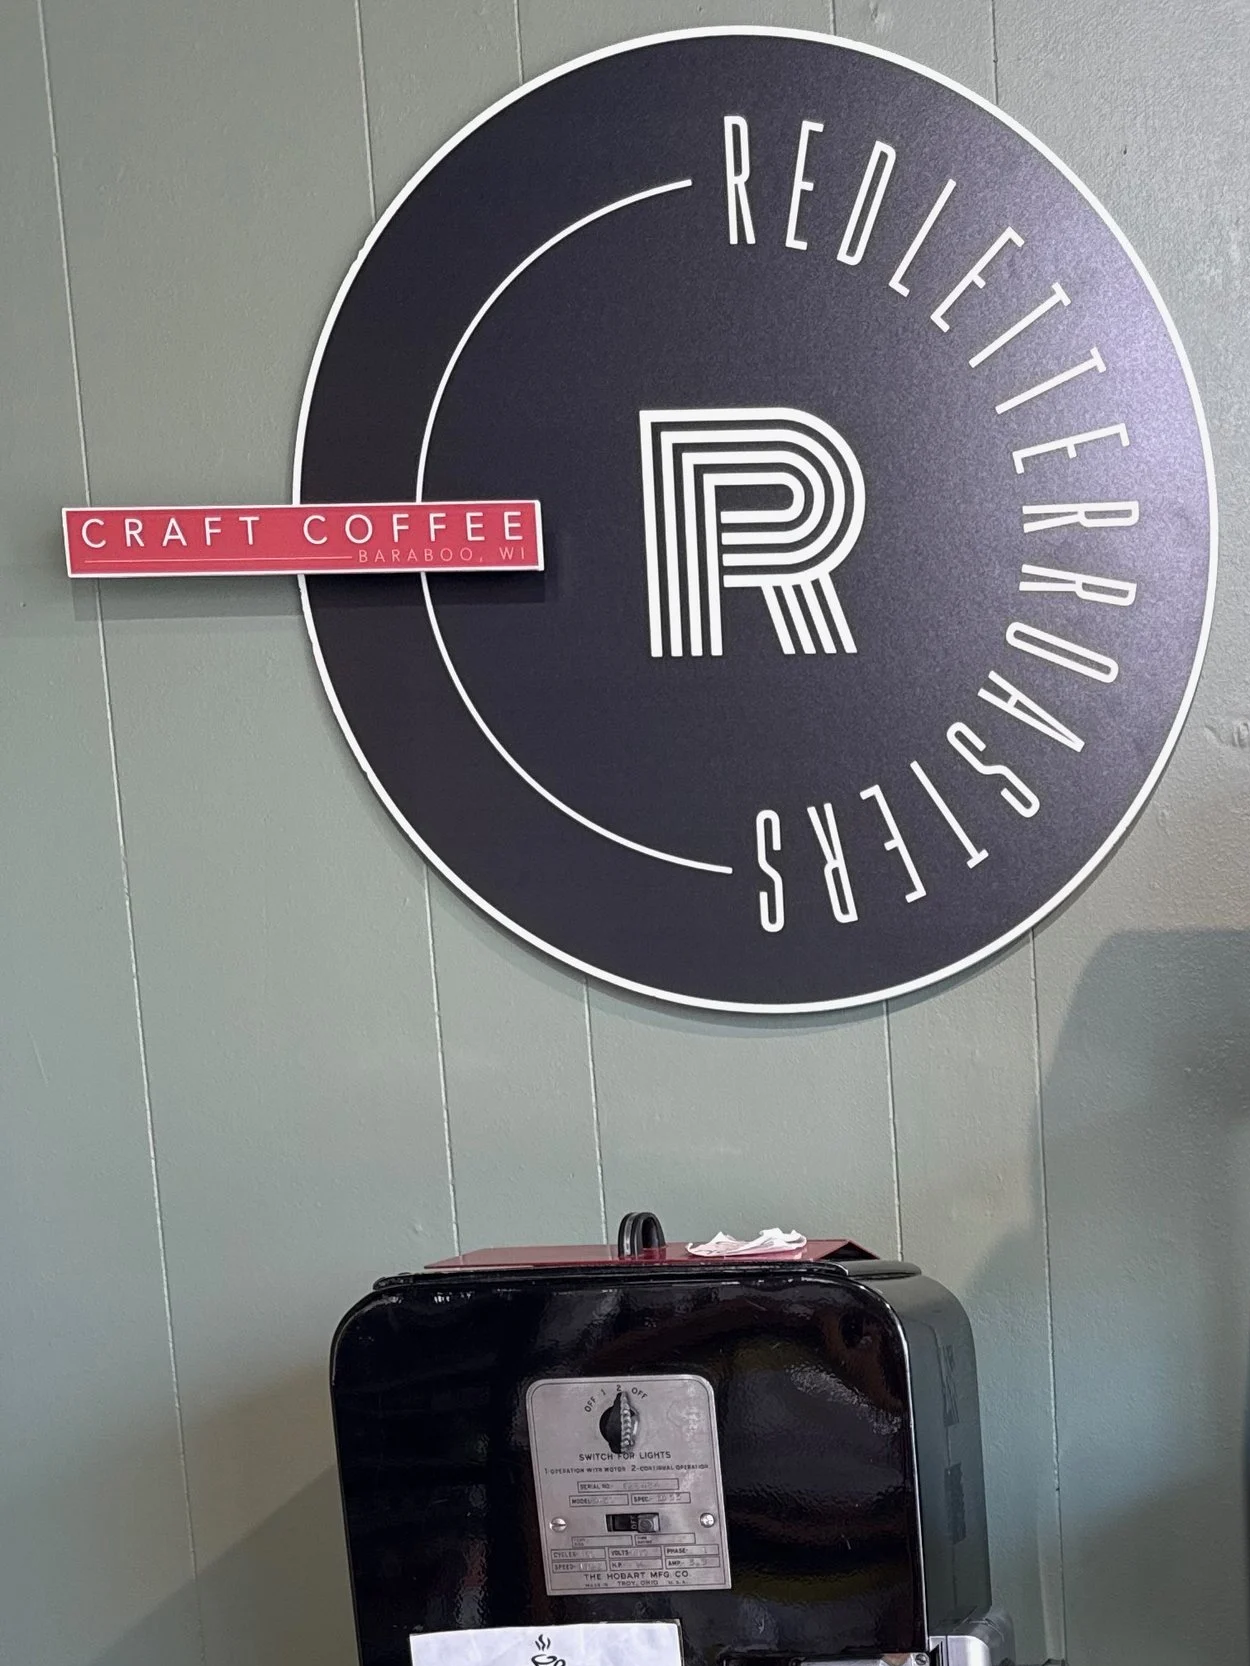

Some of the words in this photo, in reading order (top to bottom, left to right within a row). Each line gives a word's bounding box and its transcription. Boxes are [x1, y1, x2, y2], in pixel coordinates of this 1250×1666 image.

[81, 516, 260, 549] CRAFT
[303, 511, 524, 545] COFFEE
[639, 407, 867, 657] R
[358, 547, 484, 563] BARABOO,
[499, 546, 525, 560] WI
[584, 1396, 596, 1412] OFF
[631, 1387, 648, 1399] OFF
[579, 1453, 613, 1461] SWITCH
[607, 1572, 645, 1580] HOBART
